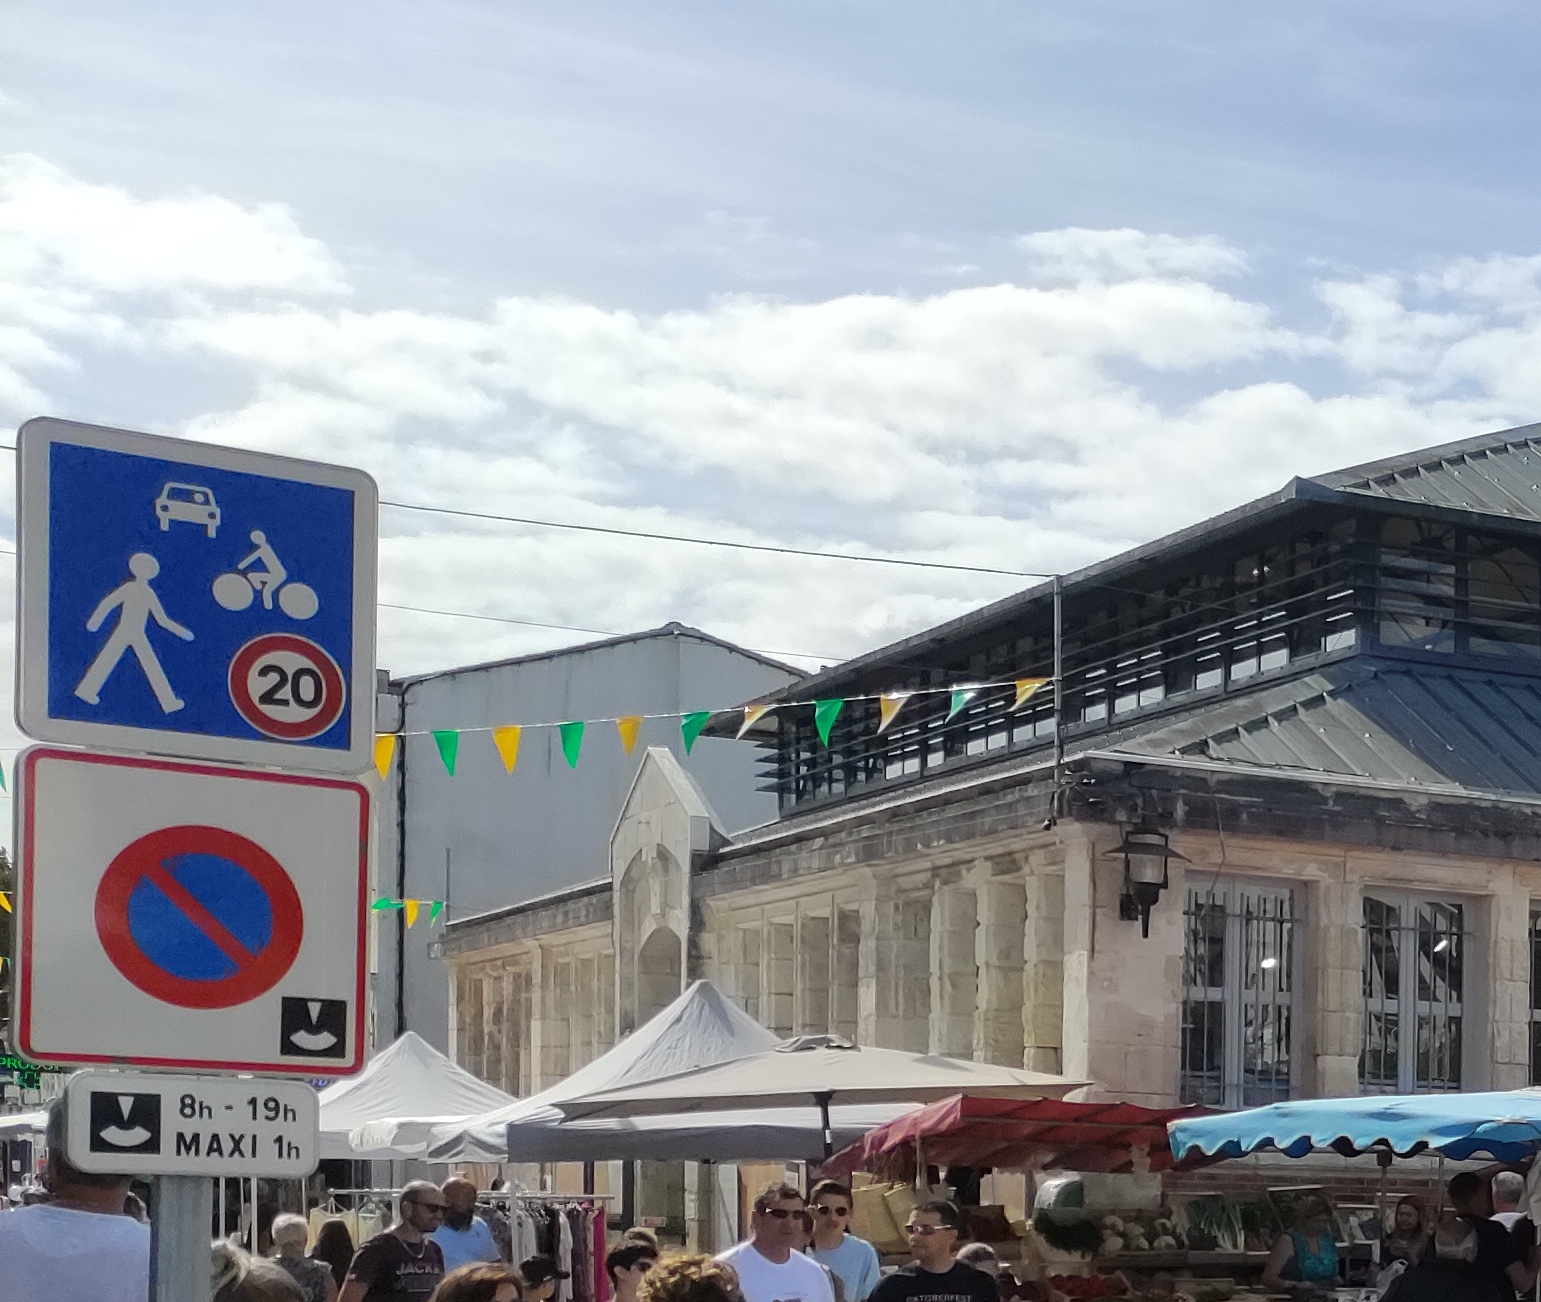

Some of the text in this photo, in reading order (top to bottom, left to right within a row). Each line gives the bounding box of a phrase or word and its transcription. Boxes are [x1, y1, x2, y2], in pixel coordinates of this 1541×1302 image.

[257, 664, 323, 710] 20
[179, 1093, 213, 1119] 8h
[246, 1095, 297, 1122] 19h
[175, 1131, 300, 1160] MAXI 1h
